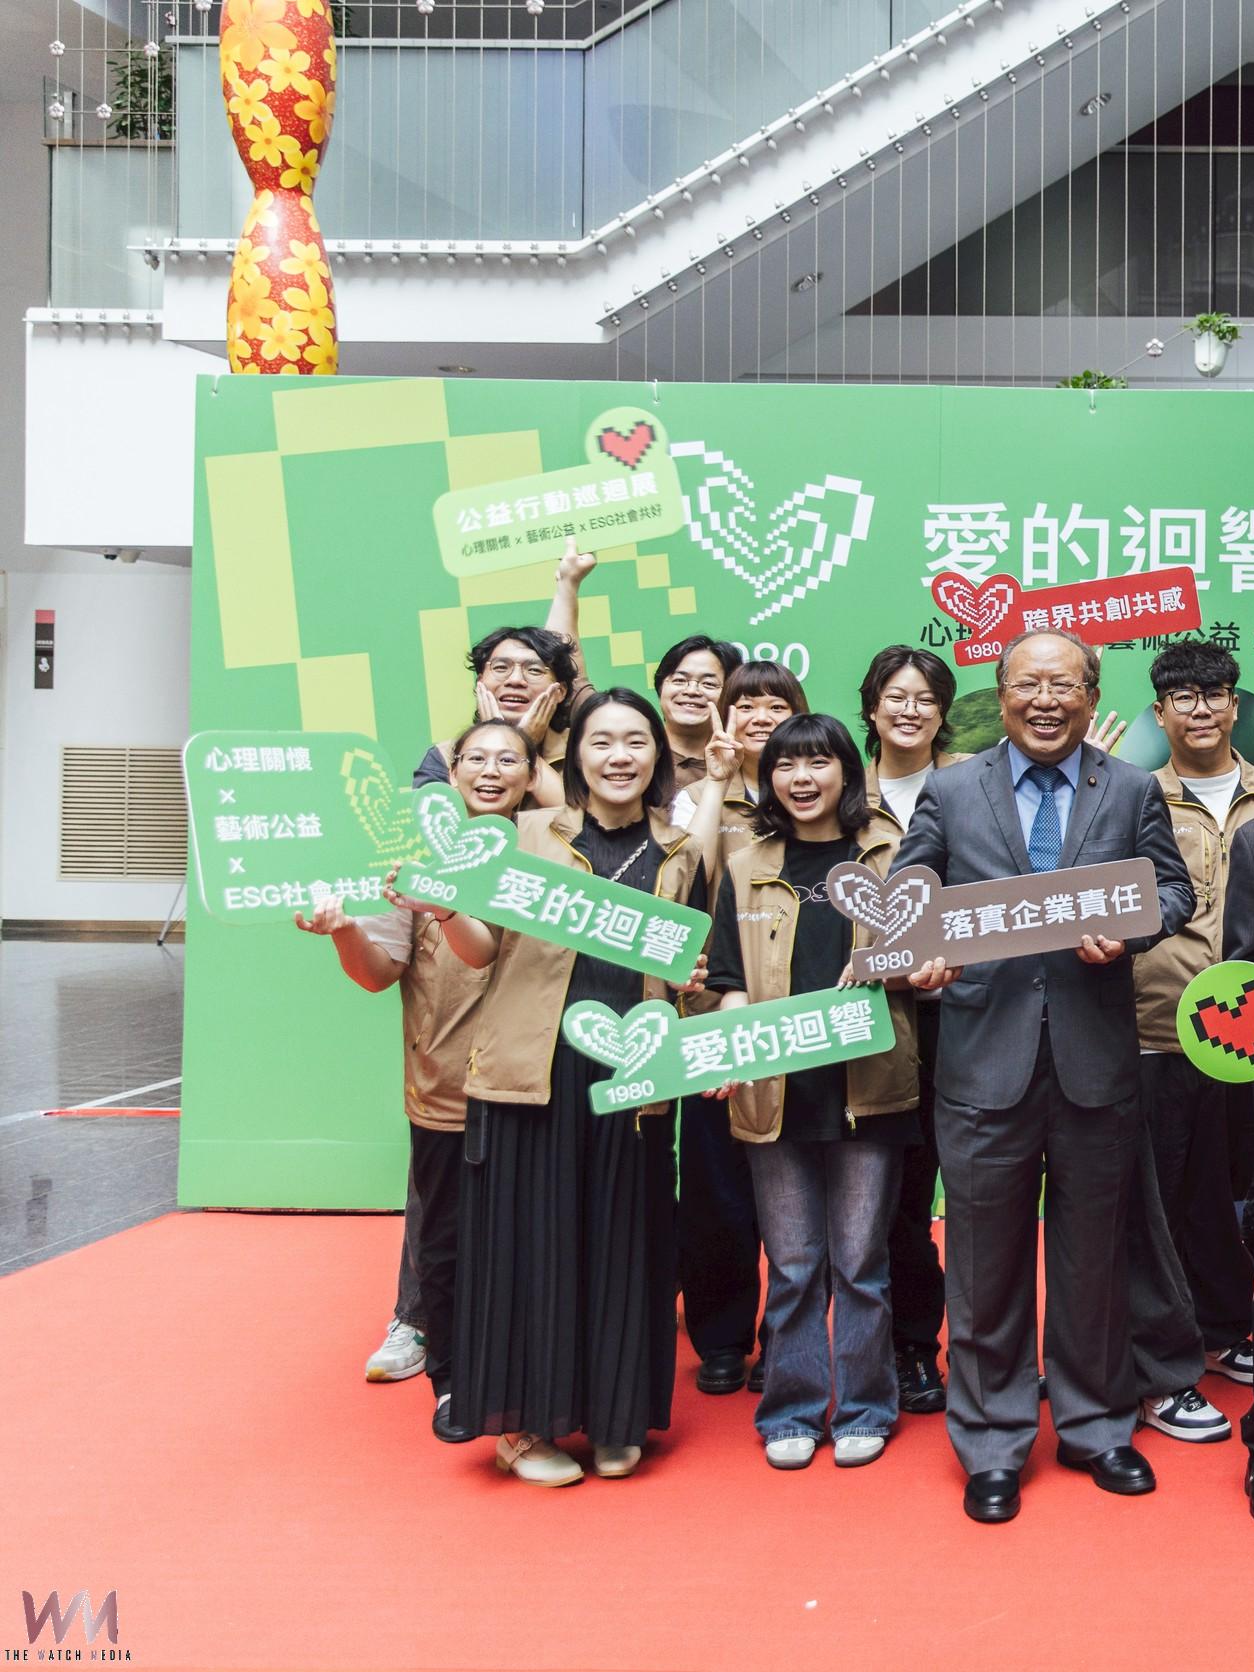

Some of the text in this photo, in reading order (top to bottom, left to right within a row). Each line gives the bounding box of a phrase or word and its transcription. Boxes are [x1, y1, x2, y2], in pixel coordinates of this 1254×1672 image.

[456, 471, 659, 534] 公益行動巡迴展
[461, 535, 511, 557] 心理關懷
[526, 523, 576, 546] 藝術公益
[590, 504, 662, 531] ESG社會共好
[1022, 586, 1186, 633] 跨界共創共感
[964, 641, 1002, 660] 1980
[205, 747, 313, 772] 心理關懷
[214, 813, 323, 842] 藝術公益
[224, 876, 384, 910] ESG社會共好
[409, 873, 458, 901] 1980
[489, 866, 692, 966] 愛的迴響
[940, 882, 1142, 942] 落實企業責任
[865, 950, 914, 972] 1980
[681, 999, 876, 1080] 愛的迴響
[606, 1079, 655, 1104] 1980
